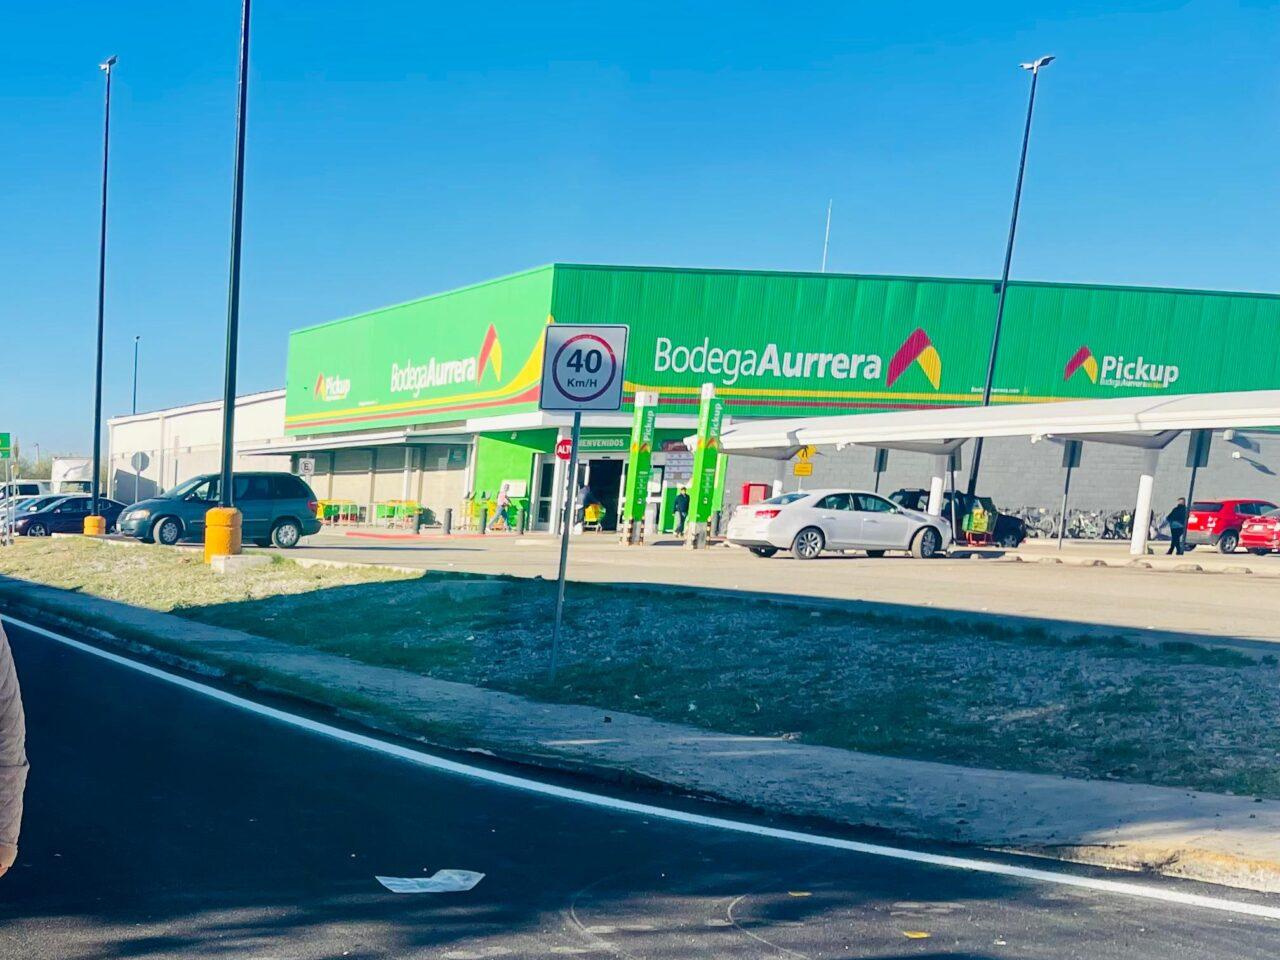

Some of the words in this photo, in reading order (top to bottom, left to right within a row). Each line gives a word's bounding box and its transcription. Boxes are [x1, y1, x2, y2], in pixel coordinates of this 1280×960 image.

[566, 349, 602, 374] 40
[653, 336, 882, 385] BodegaAurrera
[1100, 355, 1180, 388] Pickup
[390, 356, 476, 398] BodegaAurrera
[567, 378, 598, 388] Km/H
[710, 403, 723, 436] Pickup
[558, 445, 572, 454] ALT
[578, 438, 624, 447] IENVENIDOS
